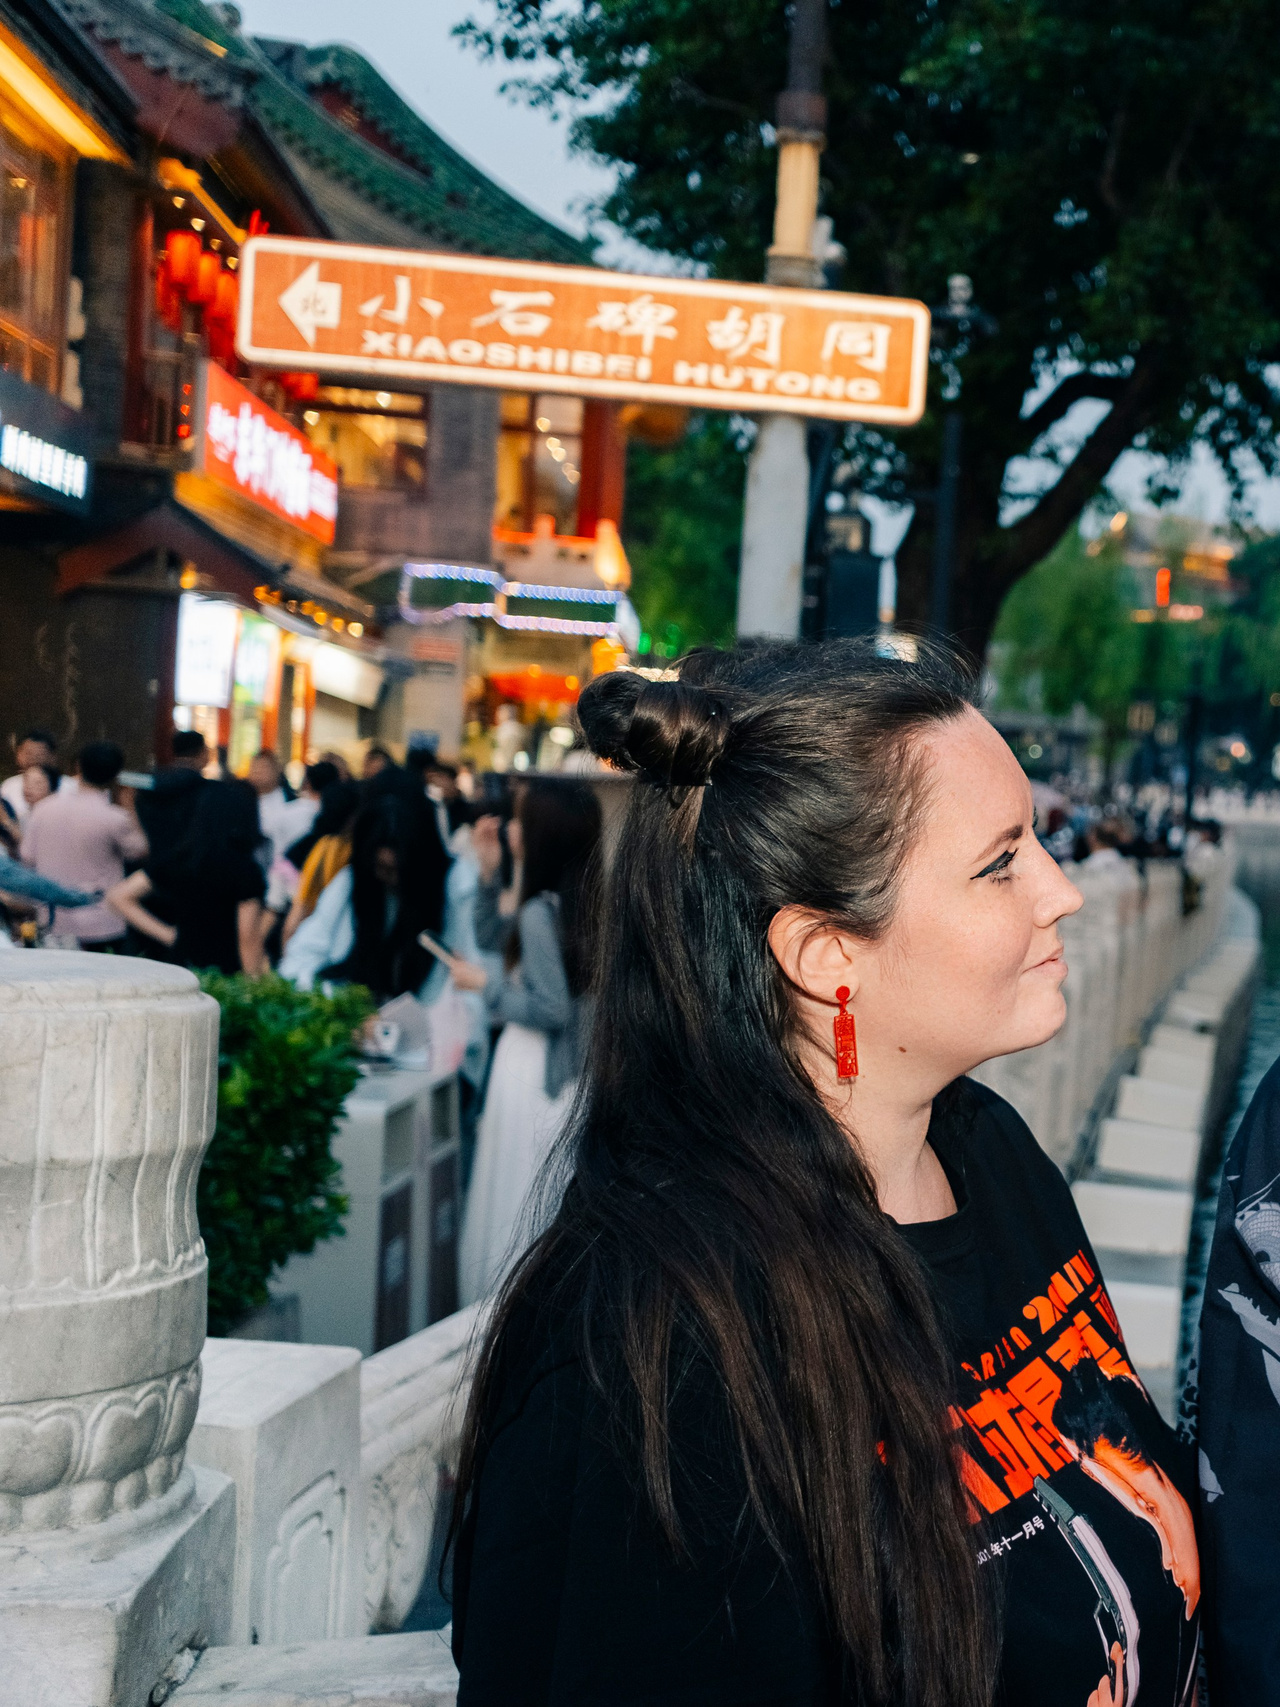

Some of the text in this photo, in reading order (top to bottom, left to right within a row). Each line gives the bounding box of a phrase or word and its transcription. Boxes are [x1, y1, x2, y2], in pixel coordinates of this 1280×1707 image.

[358, 274, 891, 373] 小石碑胡同
[361, 329, 881, 402] XIAOSHIBEI HUTONG
